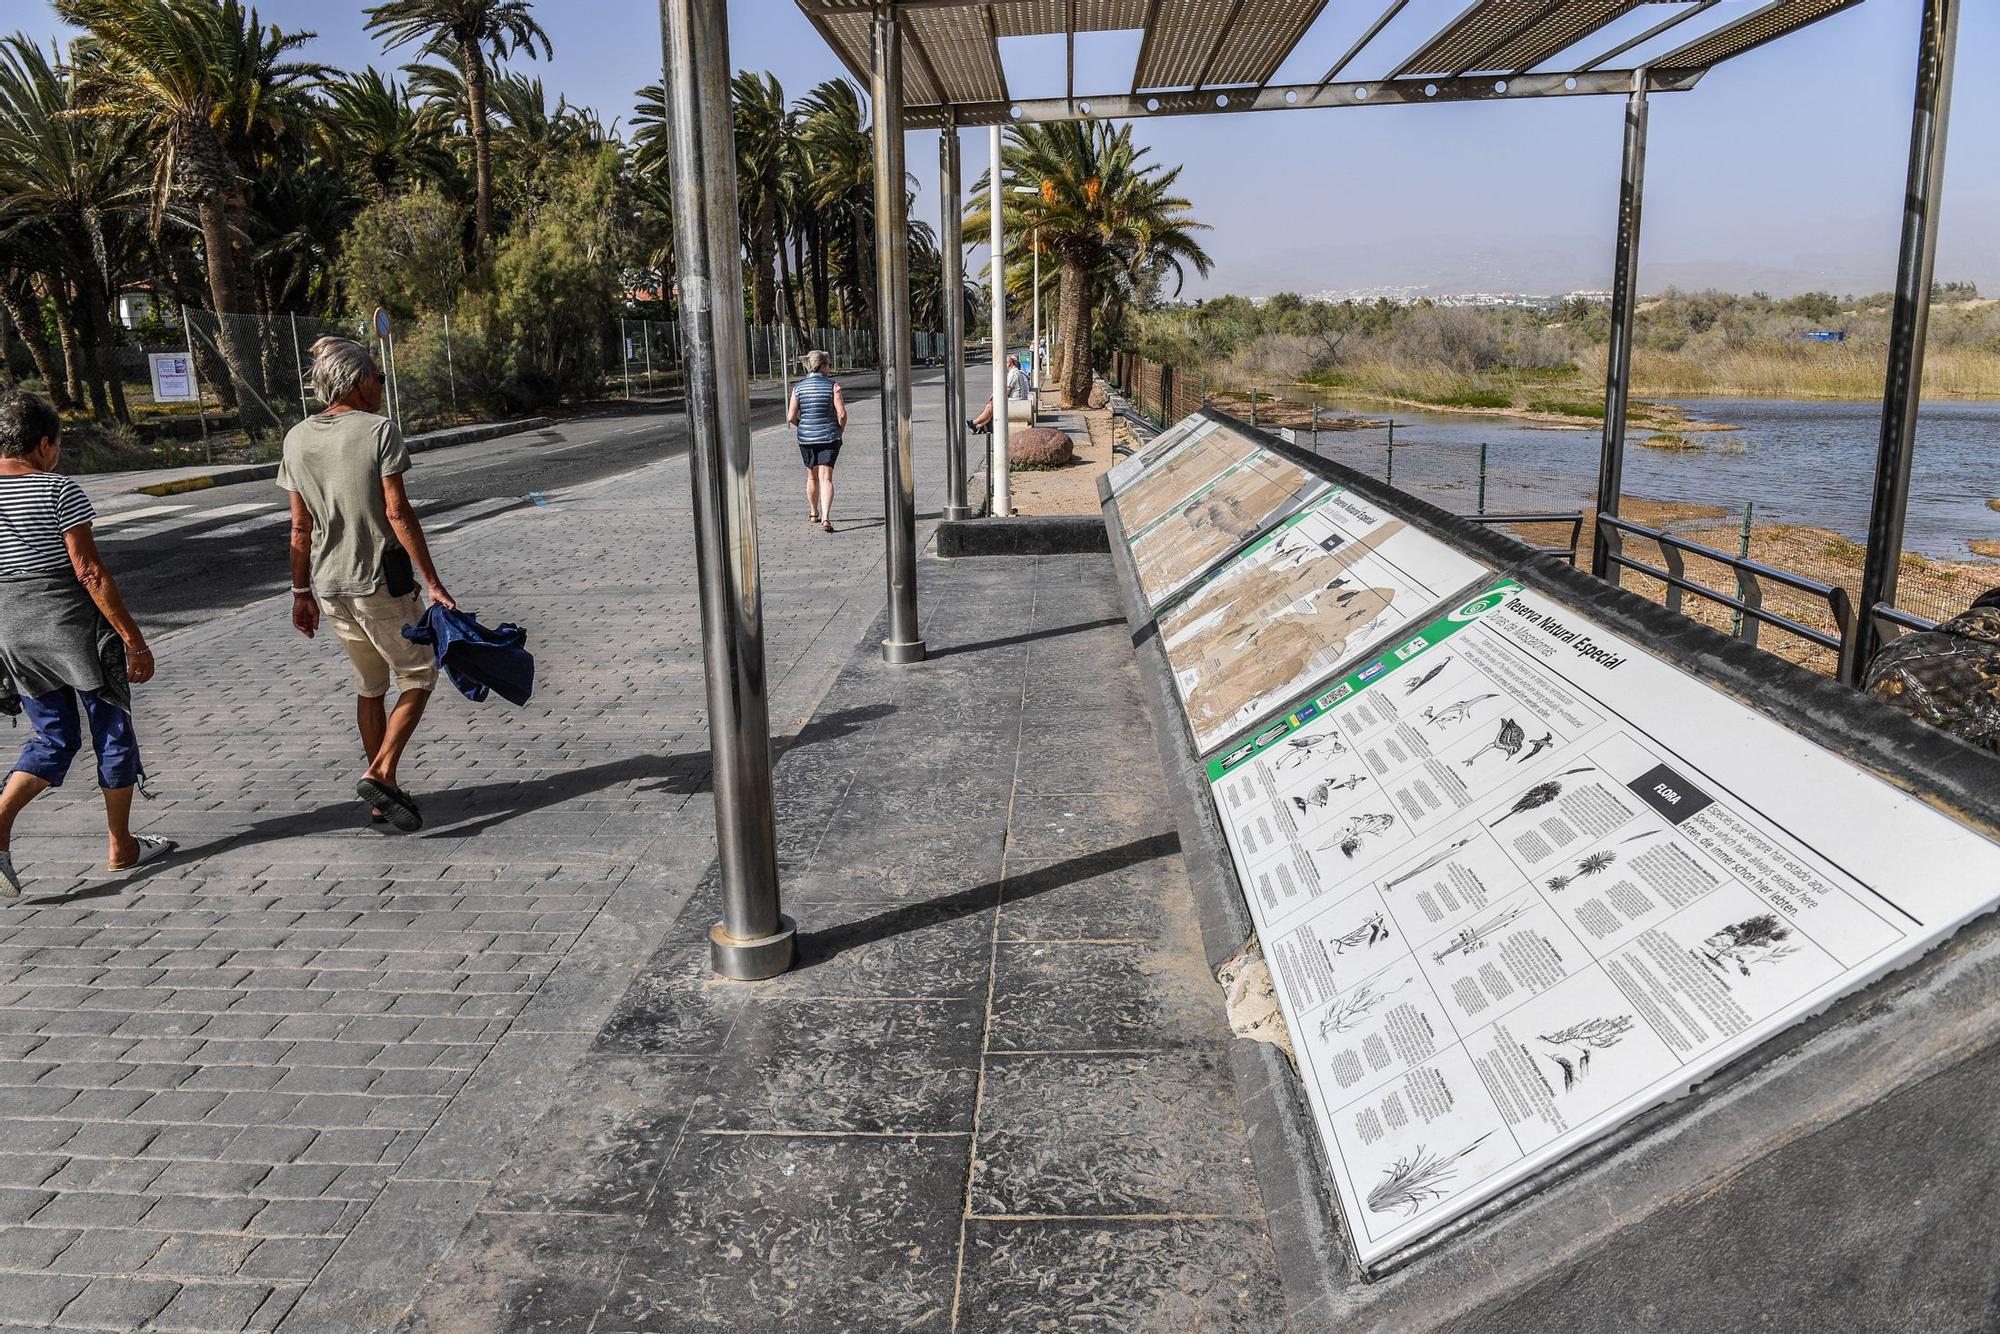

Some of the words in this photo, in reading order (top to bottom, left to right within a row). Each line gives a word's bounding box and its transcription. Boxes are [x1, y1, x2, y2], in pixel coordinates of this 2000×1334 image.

[1485, 609, 1510, 626] Dunas
[1503, 621, 1520, 632] de
[1504, 597, 1542, 623] Reserva
[1536, 616, 1582, 643] Natural
[1572, 637, 1626, 669] Especial
[1511, 626, 1557, 657] Maspalomas
[1653, 783, 1681, 804] FLORA
[1691, 812, 1718, 833] Species
[1712, 829, 1738, 847] which
[1732, 842, 1752, 859] have
[1747, 856, 1775, 876] always
[1770, 873, 1804, 895] existed
[1795, 891, 1818, 909] here
[1706, 803, 1735, 826] Especies
[1730, 823, 1747, 835] que
[1743, 832, 1772, 853] siempre
[1768, 848, 1787, 864] han
[1783, 861, 1811, 882] estado
[1679, 821, 1703, 841] Arten,
[1699, 837, 1714, 850] die
[1710, 844, 1736, 865] immer
[1731, 863, 1759, 882] schon
[1752, 877, 1773, 894] hier
[1768, 890, 1798, 917] lebten.
